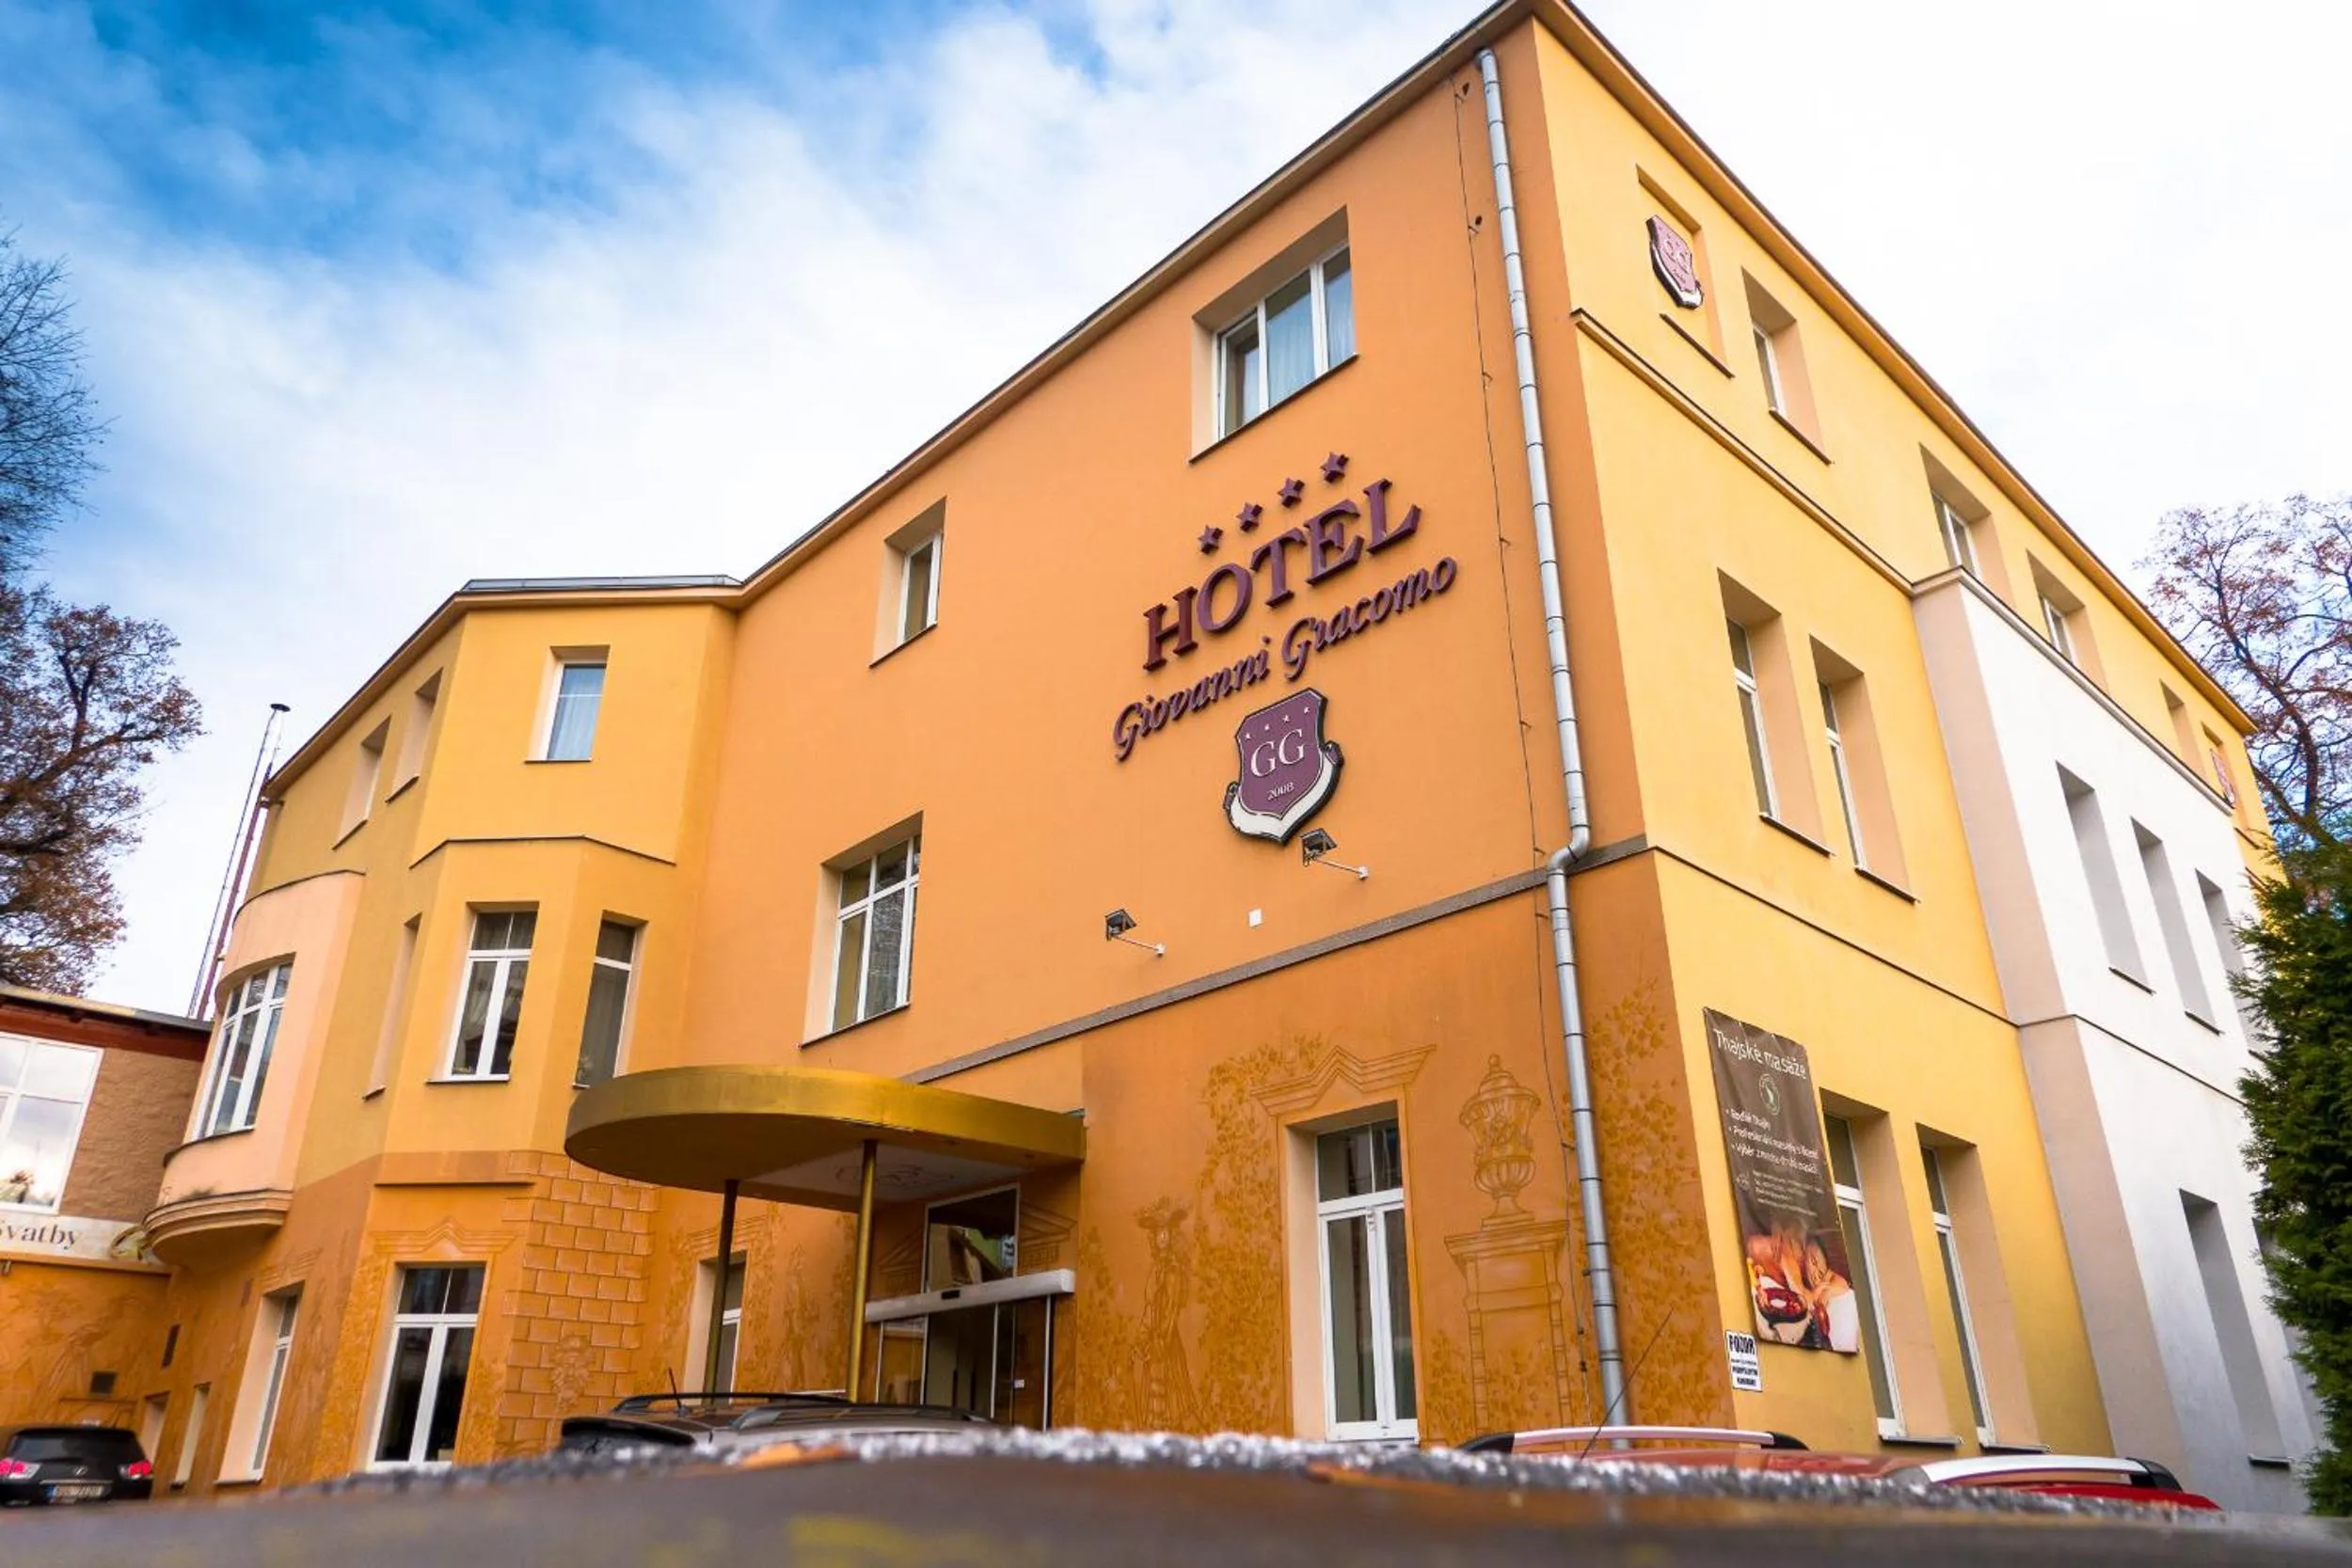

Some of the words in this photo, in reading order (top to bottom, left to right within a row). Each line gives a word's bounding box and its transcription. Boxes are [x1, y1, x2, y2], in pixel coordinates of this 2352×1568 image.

[1142, 478, 1422, 672] HOTEL
[1113, 636, 1272, 763] Giovanni
[1250, 728, 1306, 778] GG
[0, 1224, 81, 1251] vatby
